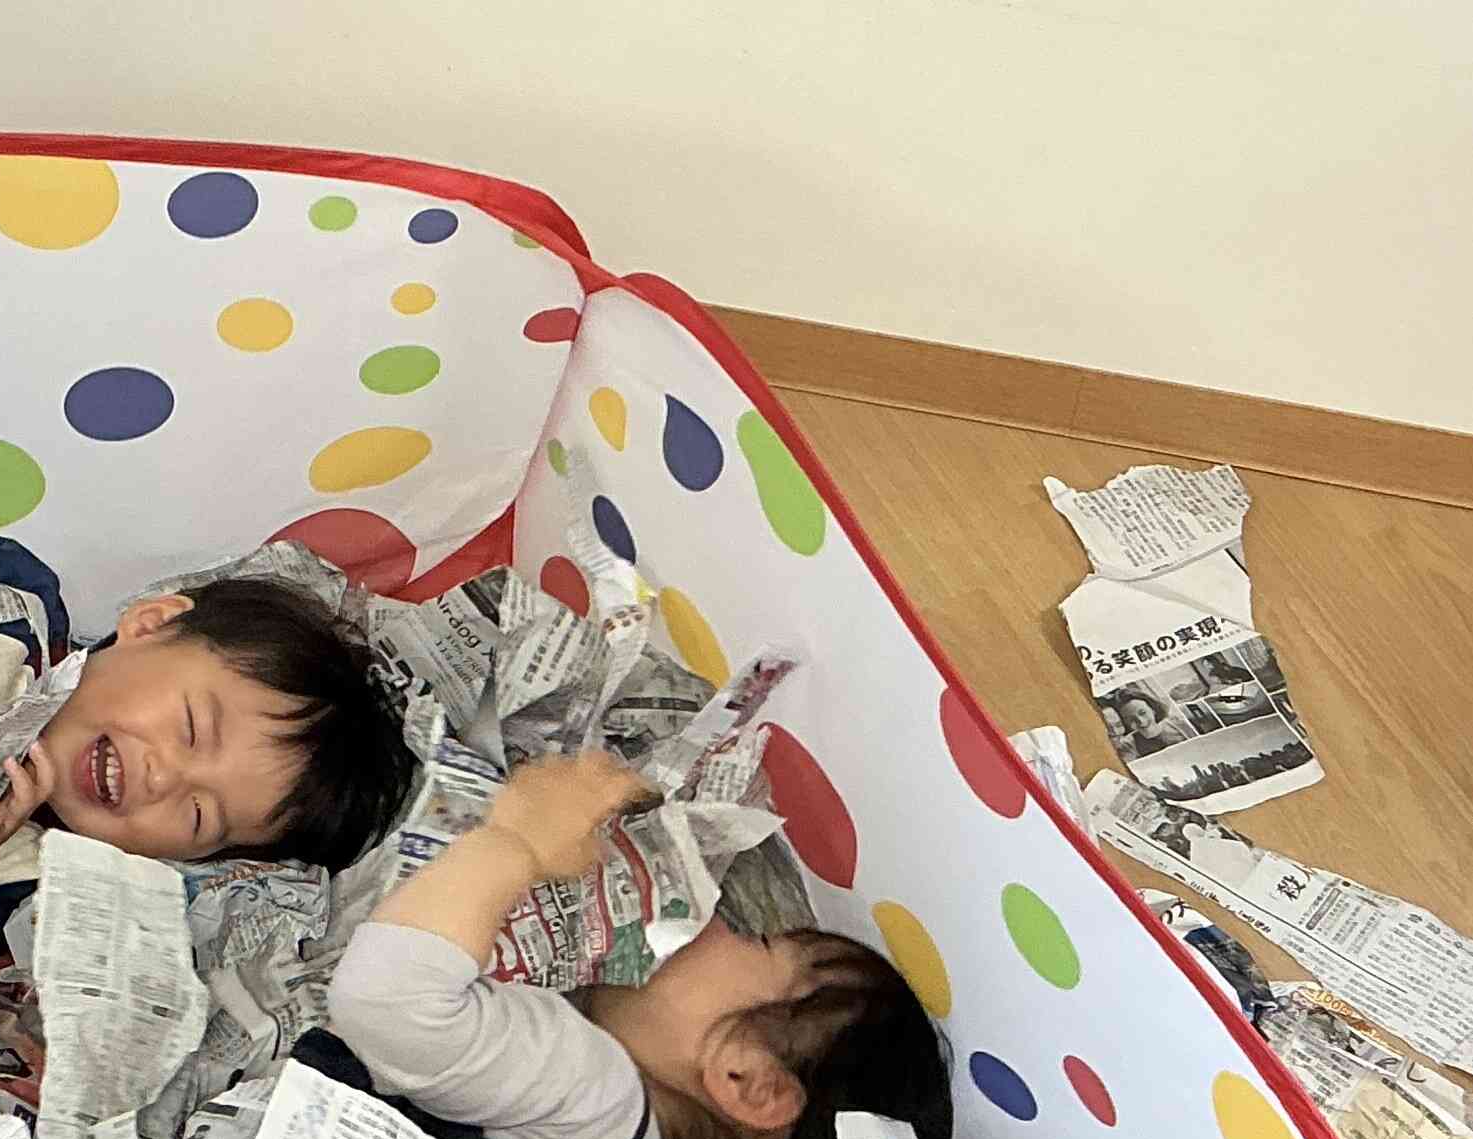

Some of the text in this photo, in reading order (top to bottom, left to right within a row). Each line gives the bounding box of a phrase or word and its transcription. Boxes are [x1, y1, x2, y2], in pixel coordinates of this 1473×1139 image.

[1088, 616, 1225, 681] る笑顔の実現
